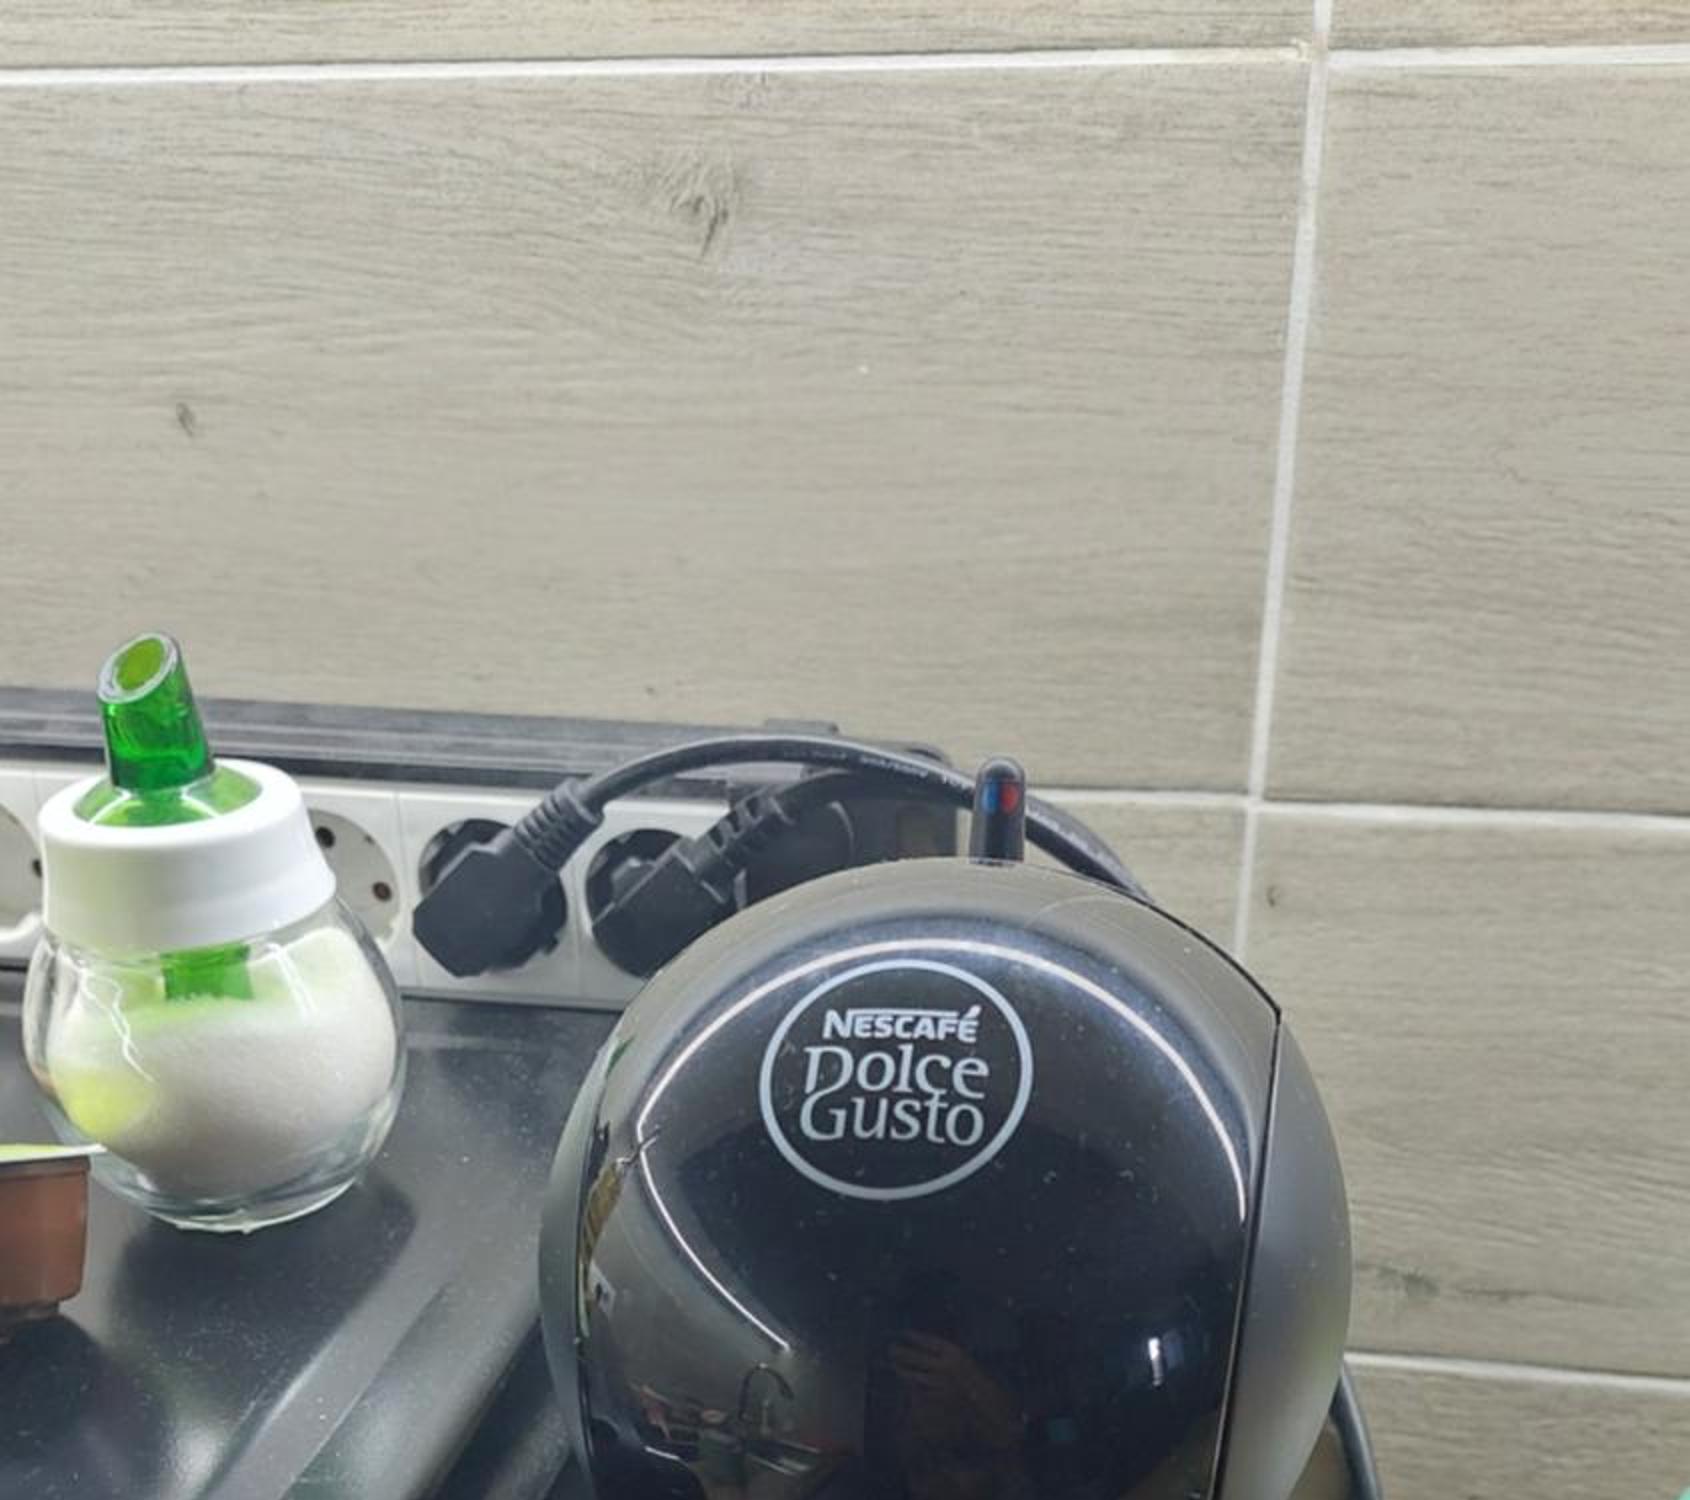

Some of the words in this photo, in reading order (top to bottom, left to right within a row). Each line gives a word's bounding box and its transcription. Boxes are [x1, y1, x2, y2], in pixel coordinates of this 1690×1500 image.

[822, 1005, 982, 1043] NESCAFÉ
[804, 1043, 990, 1100] Dolce
[800, 1095, 985, 1147] Gusto
